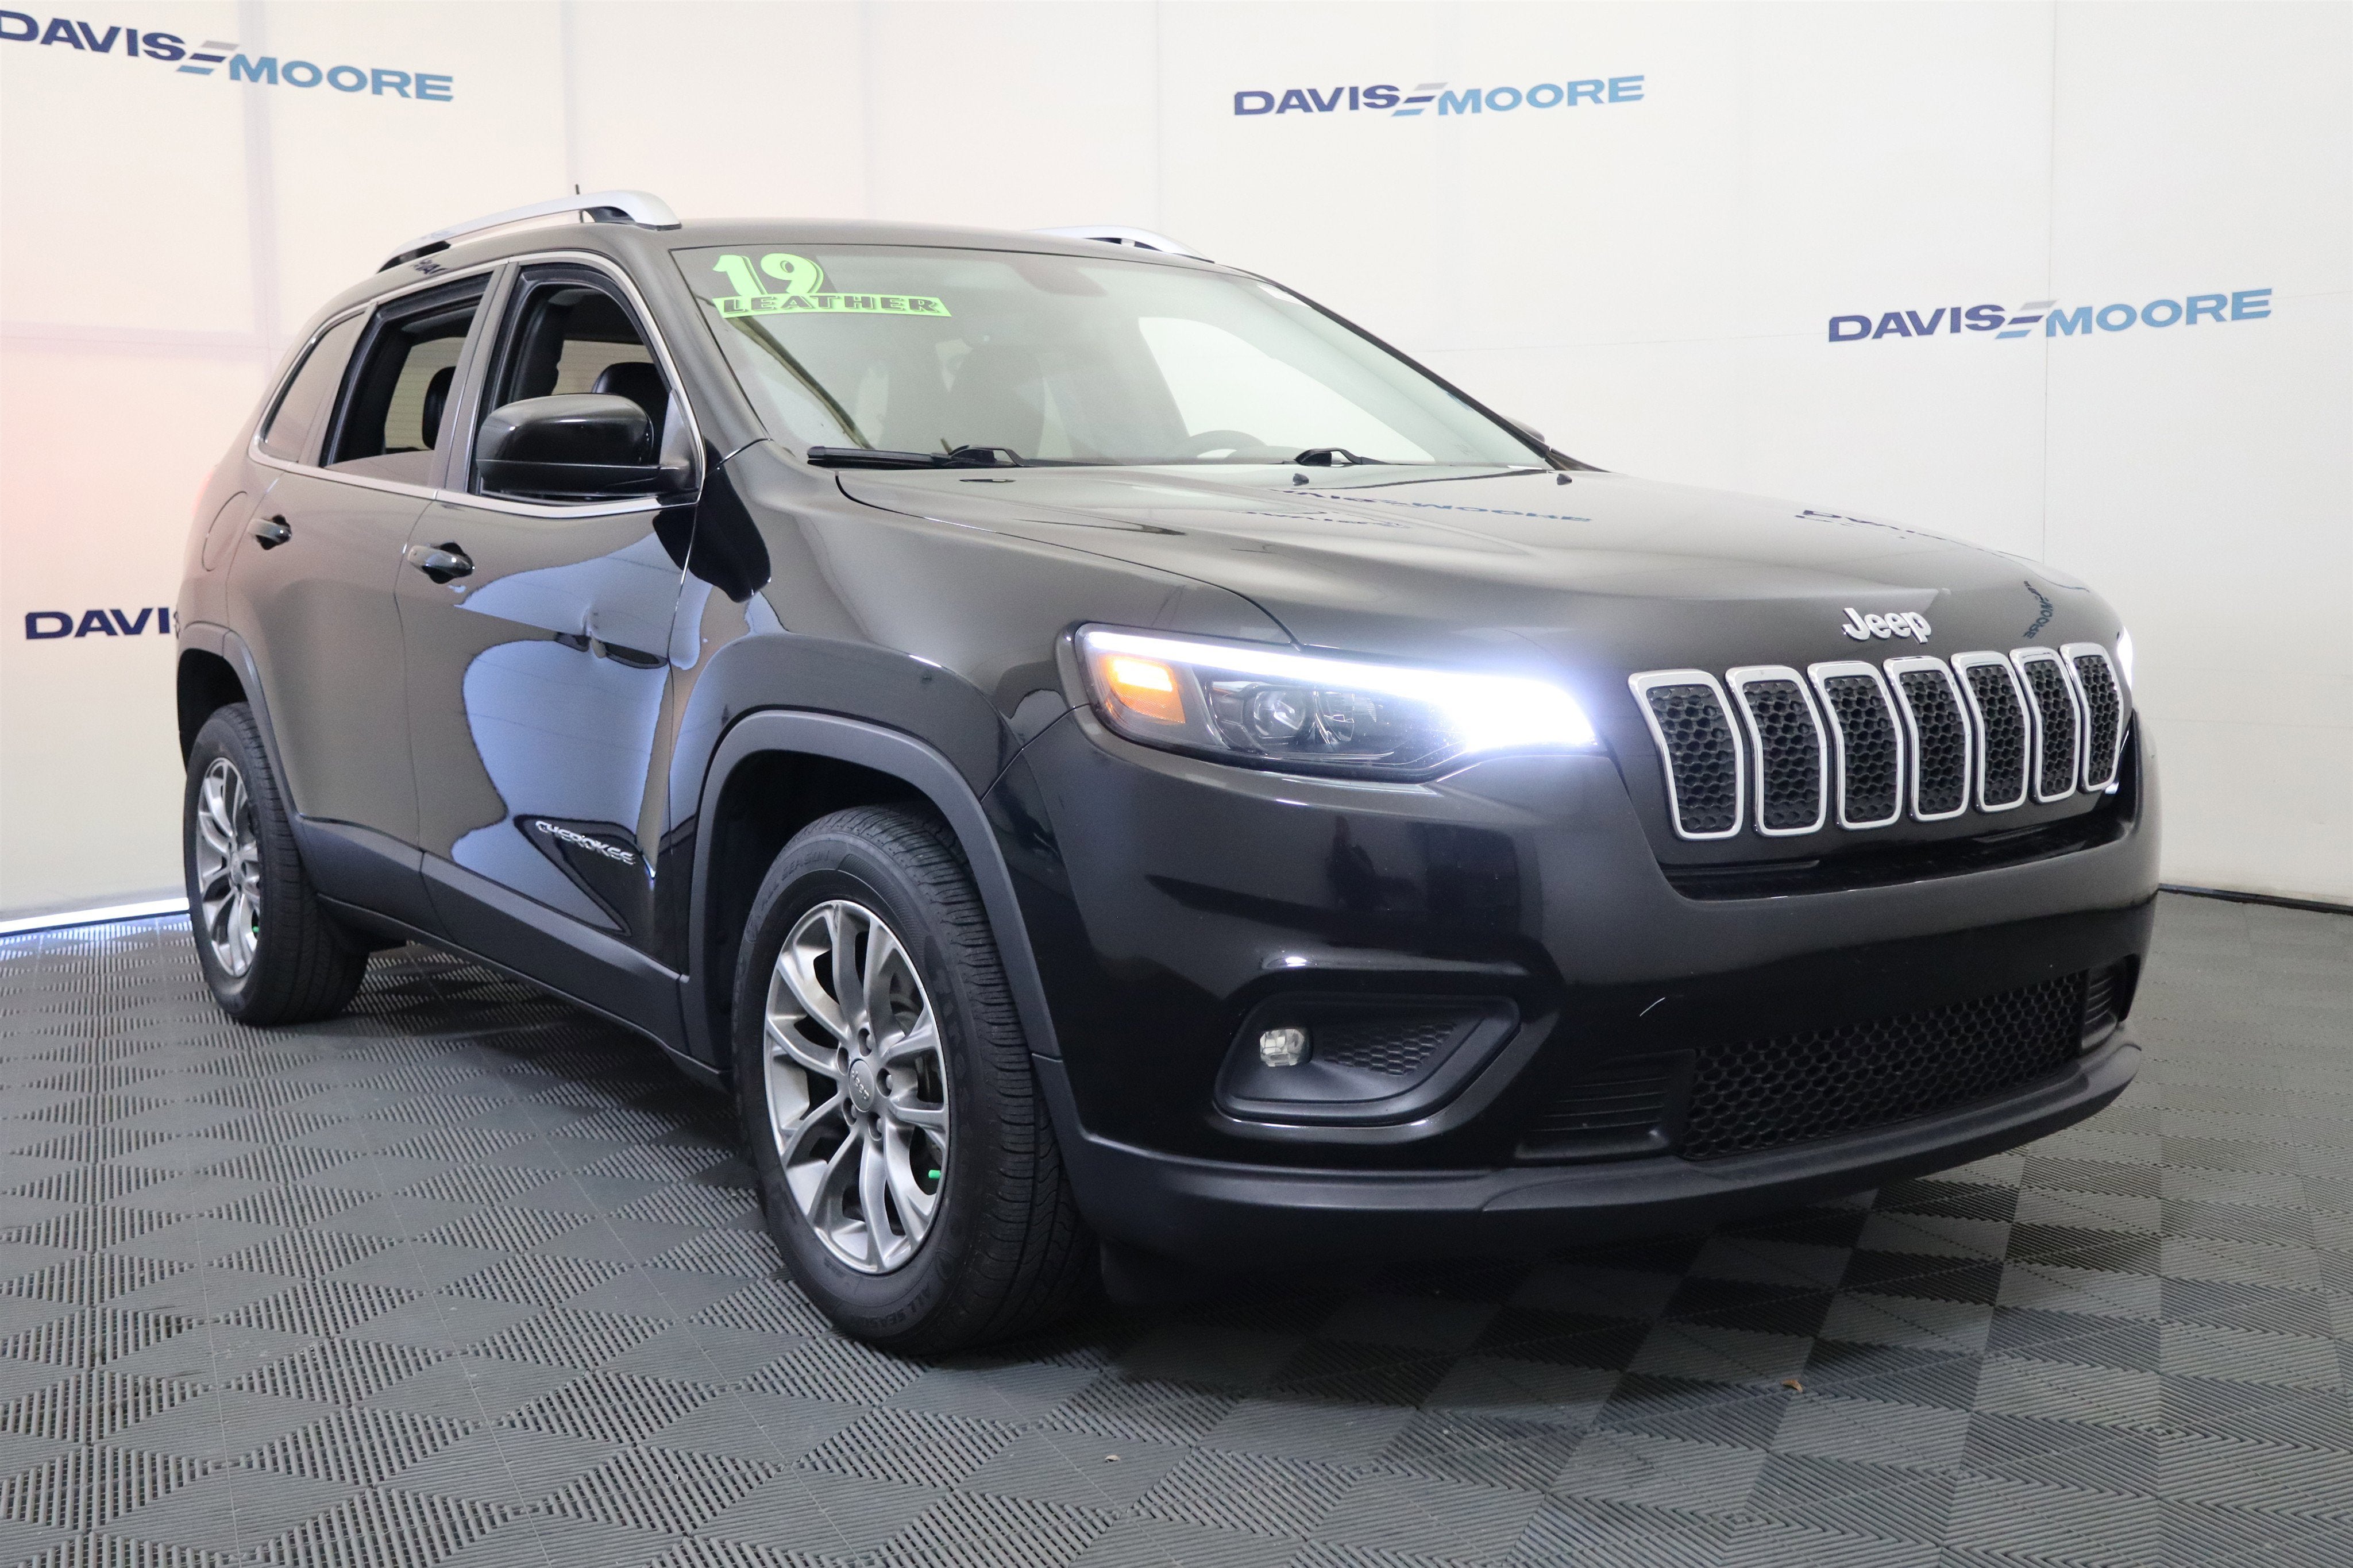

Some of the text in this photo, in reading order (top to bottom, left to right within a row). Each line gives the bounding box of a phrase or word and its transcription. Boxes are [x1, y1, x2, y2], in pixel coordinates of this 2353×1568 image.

[0, 10, 454, 102] DAVIS MOORE
[1234, 75, 1645, 116] DAVIS MOORE
[712, 253, 824, 296] 19
[723, 294, 942, 314] LEATHER
[1829, 288, 2272, 342] DAVIS MOORE
[25, 607, 178, 640] DAVI
[1841, 607, 1932, 644] Jeep
[535, 820, 637, 866] CHEROKEE
